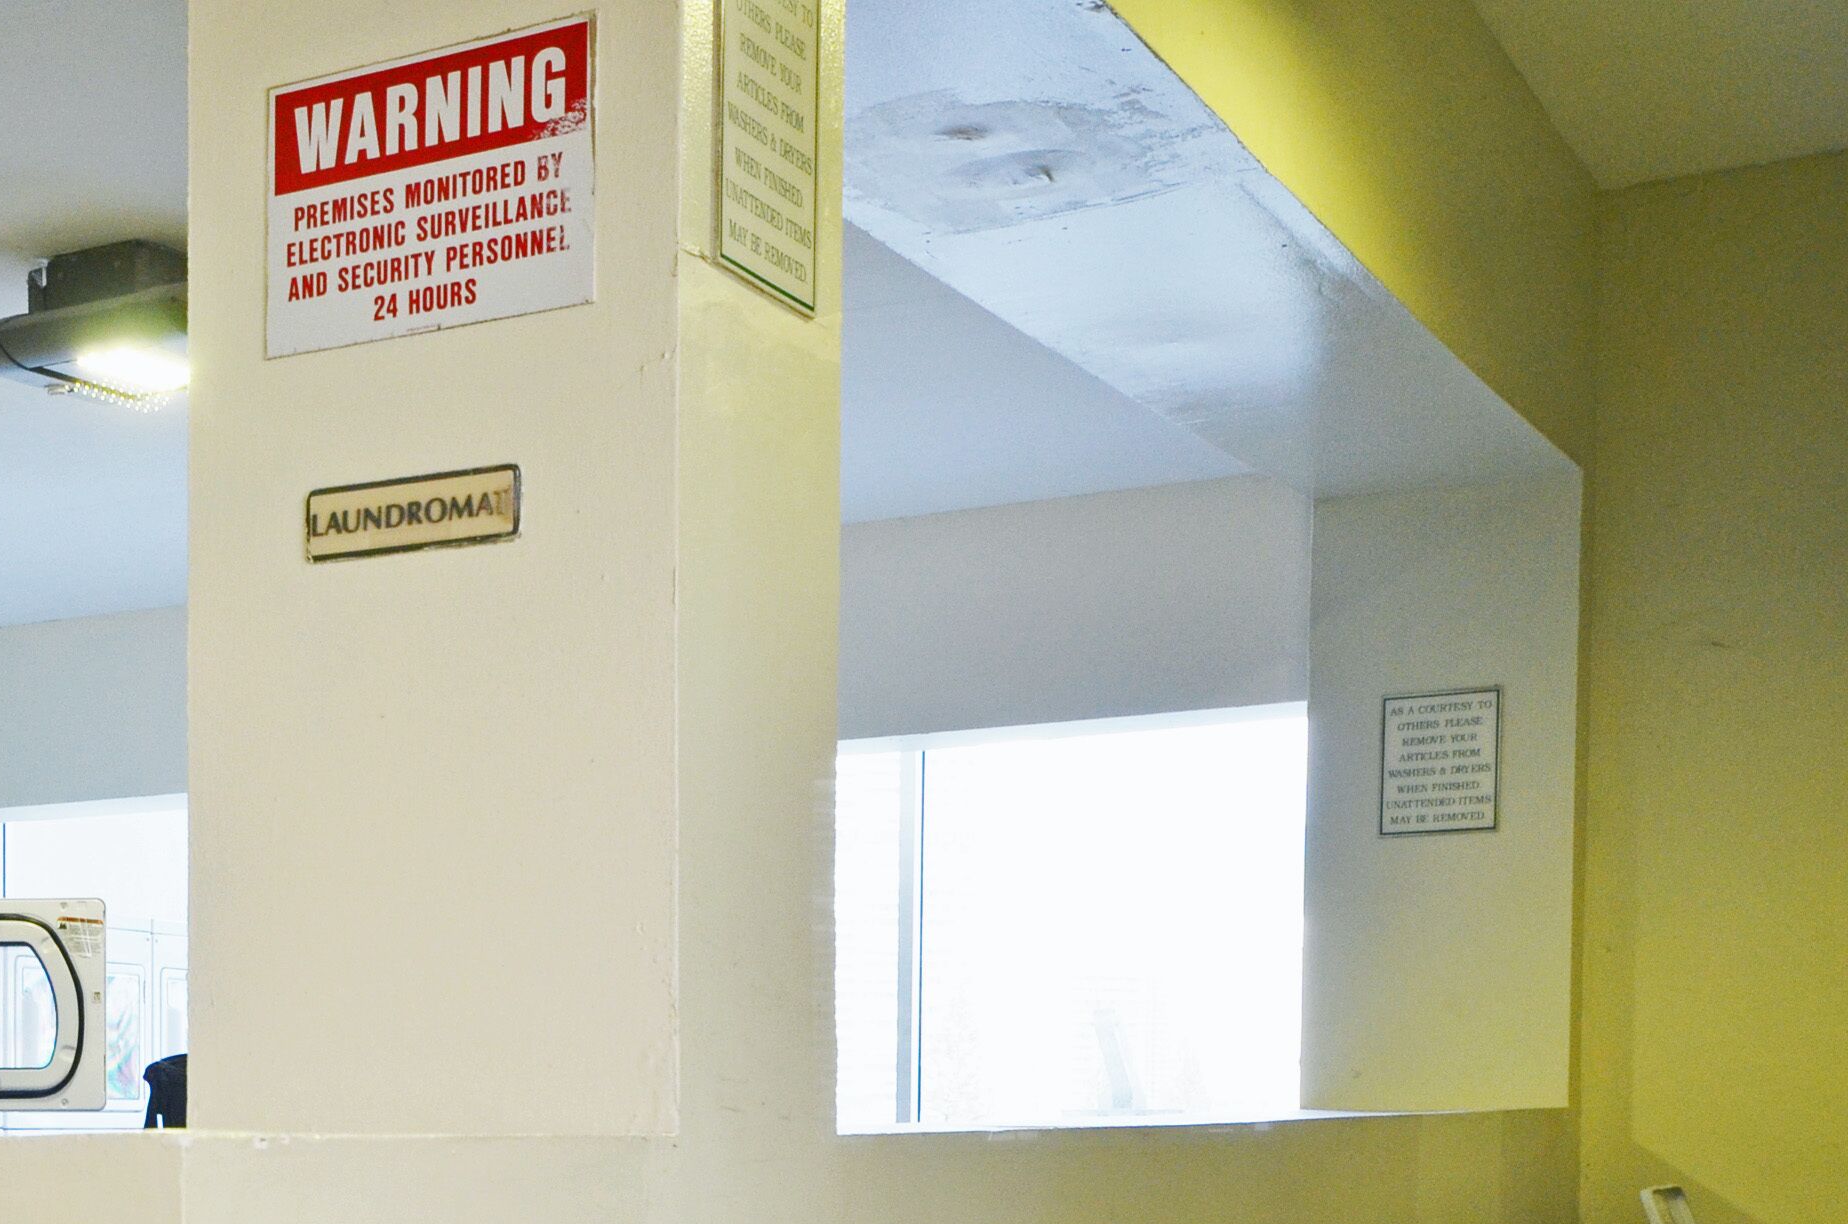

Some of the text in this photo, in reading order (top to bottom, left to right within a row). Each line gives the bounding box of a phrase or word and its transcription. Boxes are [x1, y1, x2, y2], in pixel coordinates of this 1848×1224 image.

[294, 46, 567, 175] WARNING
[286, 187, 572, 268] ELECTRONIC SURVEILLANCE
[294, 151, 563, 232] PREMISES MONITORED BY
[288, 225, 571, 302] AND SECURITY PERSONNEL
[373, 278, 477, 322] 24 HOURS
[311, 485, 511, 537] LAUNDROMAT
